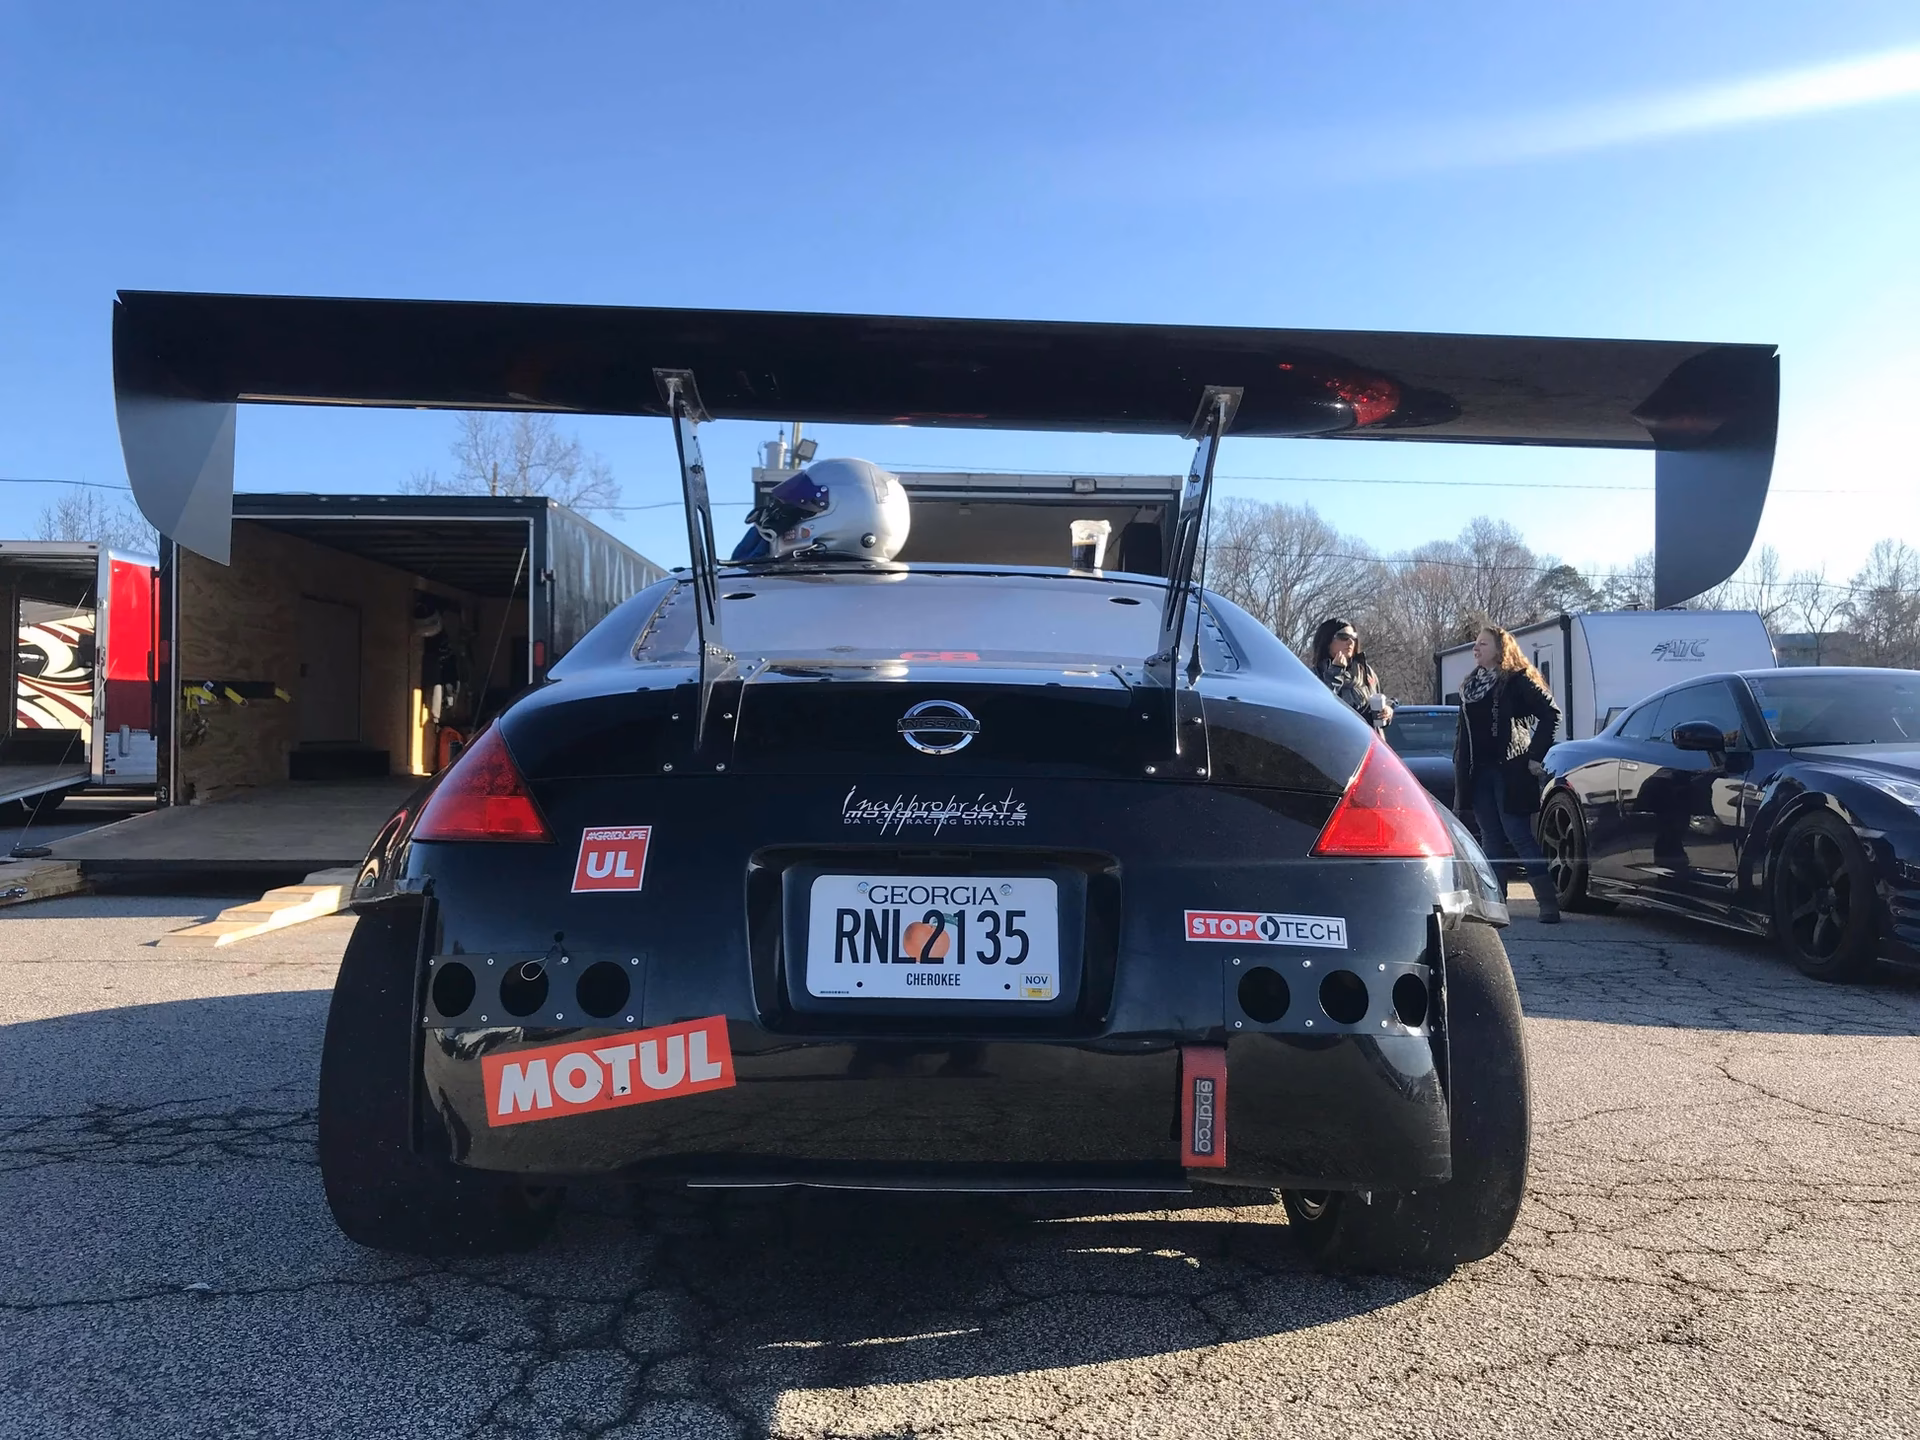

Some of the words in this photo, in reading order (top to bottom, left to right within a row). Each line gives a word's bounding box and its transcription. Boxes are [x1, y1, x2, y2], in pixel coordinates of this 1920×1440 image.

[1667, 639, 1709, 657] ATC
[905, 719, 972, 729] NISSAN
[842, 785, 1028, 836] Inappropriate
[843, 810, 1028, 820] MOTORSPORTS
[906, 818, 957, 826] RACING
[963, 819, 1026, 827] DIVISION
[586, 830, 647, 841] #GRIDLIFE
[586, 851, 634, 879] UL
[868, 885, 999, 905] GEORGIA
[834, 908, 1030, 965] RNL2135
[906, 973, 961, 986] CHEROKEE
[1025, 975, 1048, 984] NOV
[497, 1030, 722, 1115] MOTUL
